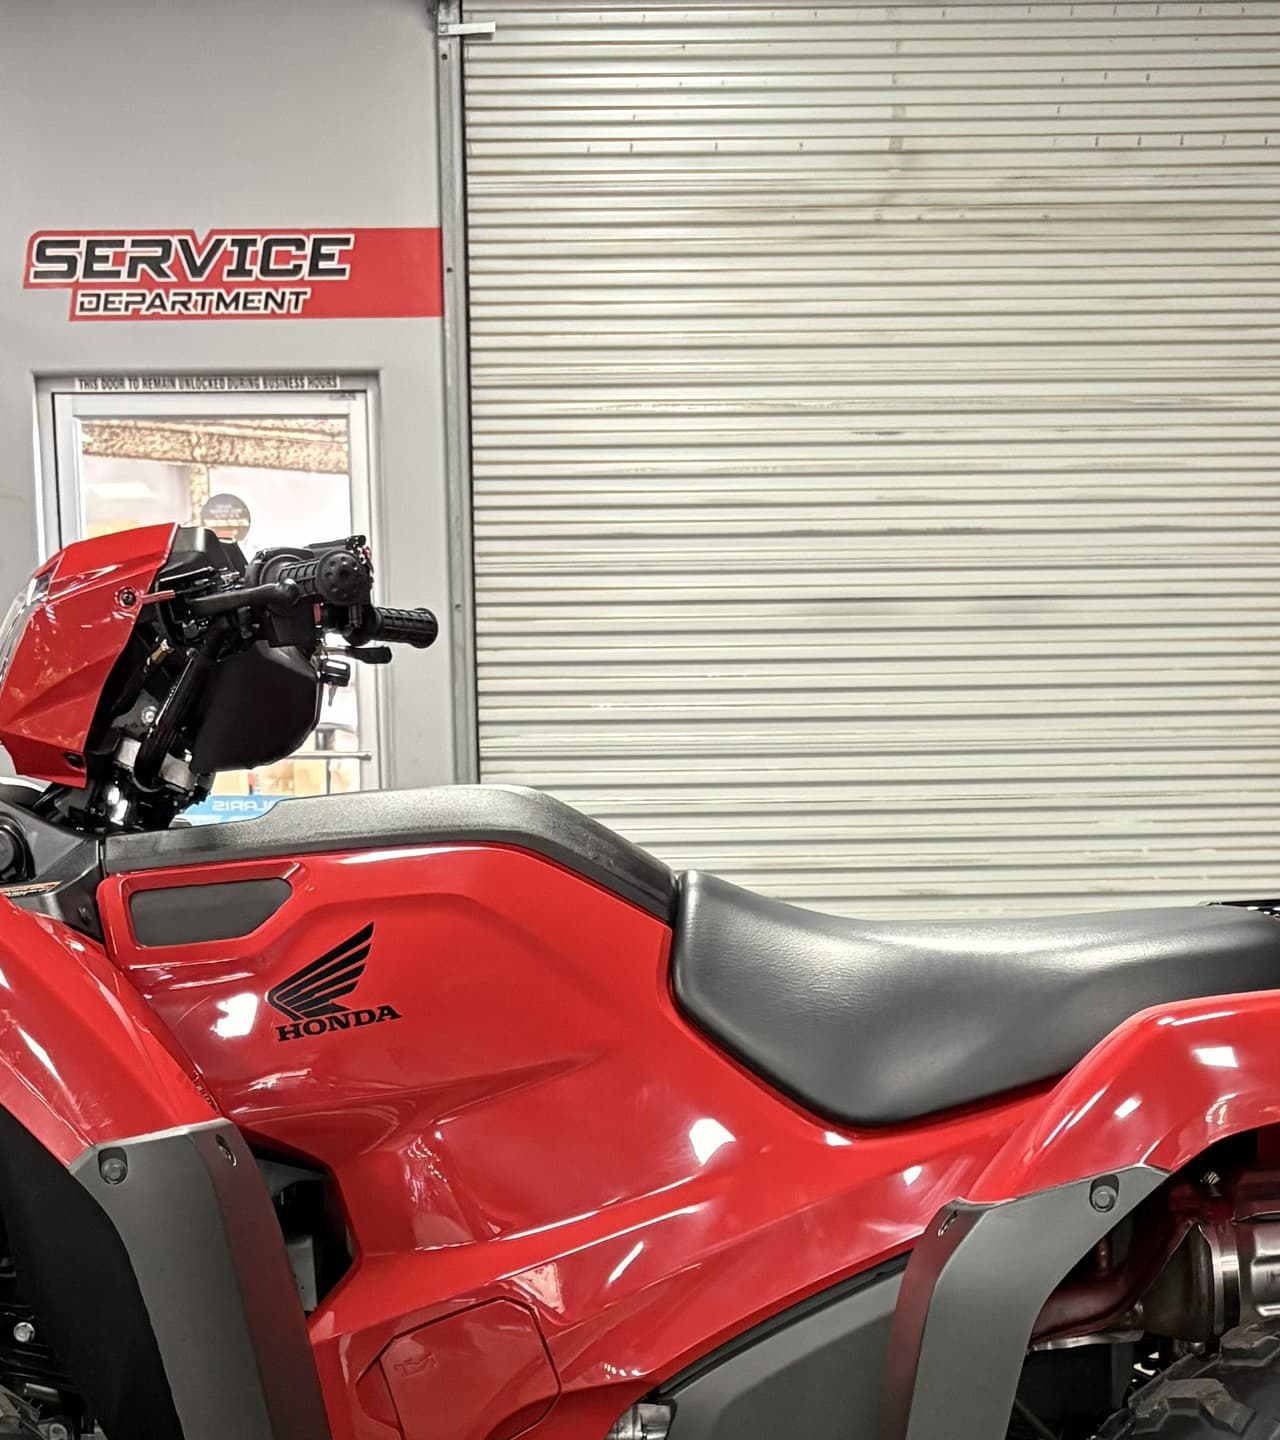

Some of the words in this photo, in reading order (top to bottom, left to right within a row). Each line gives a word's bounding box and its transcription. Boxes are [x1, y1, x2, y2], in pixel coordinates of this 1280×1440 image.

[32, 236, 353, 281] SERVICE
[78, 290, 308, 313] DEPARTMENT
[79, 378, 98, 390] THIS
[101, 378, 125, 390] DOOR
[128, 378, 141, 390] TO
[142, 378, 176, 390] REMAIN
[179, 378, 225, 390] UNLOCKED
[227, 378, 260, 390] DURING
[263, 378, 305, 390] BUSINESS
[276, 1005, 403, 1042] HONDA
